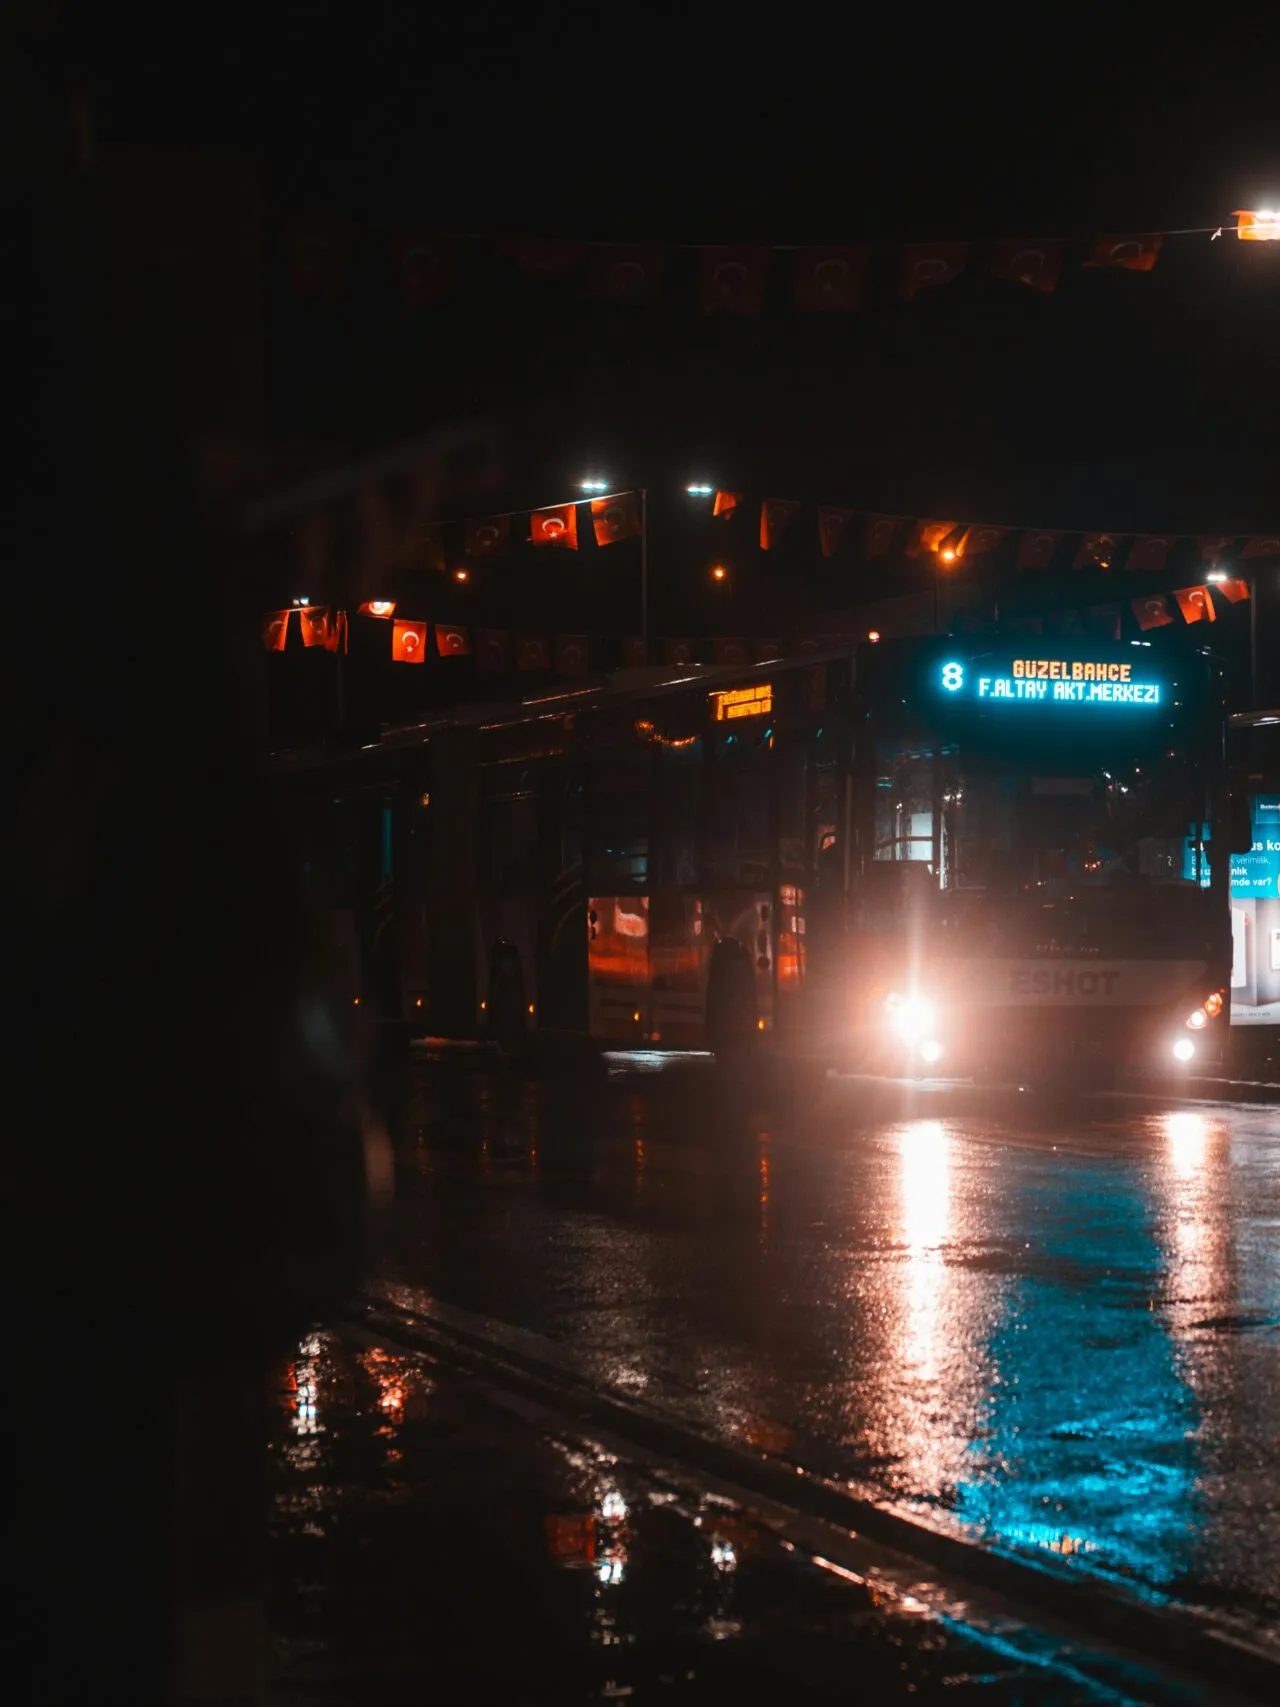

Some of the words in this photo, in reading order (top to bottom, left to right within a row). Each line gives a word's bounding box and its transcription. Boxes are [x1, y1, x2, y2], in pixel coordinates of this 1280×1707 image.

[942, 662, 963, 691] 8
[979, 678, 1047, 698] F.ALTAY
[1252, 877, 1272, 886] var?
[1013, 969, 1119, 995] ESHOT
